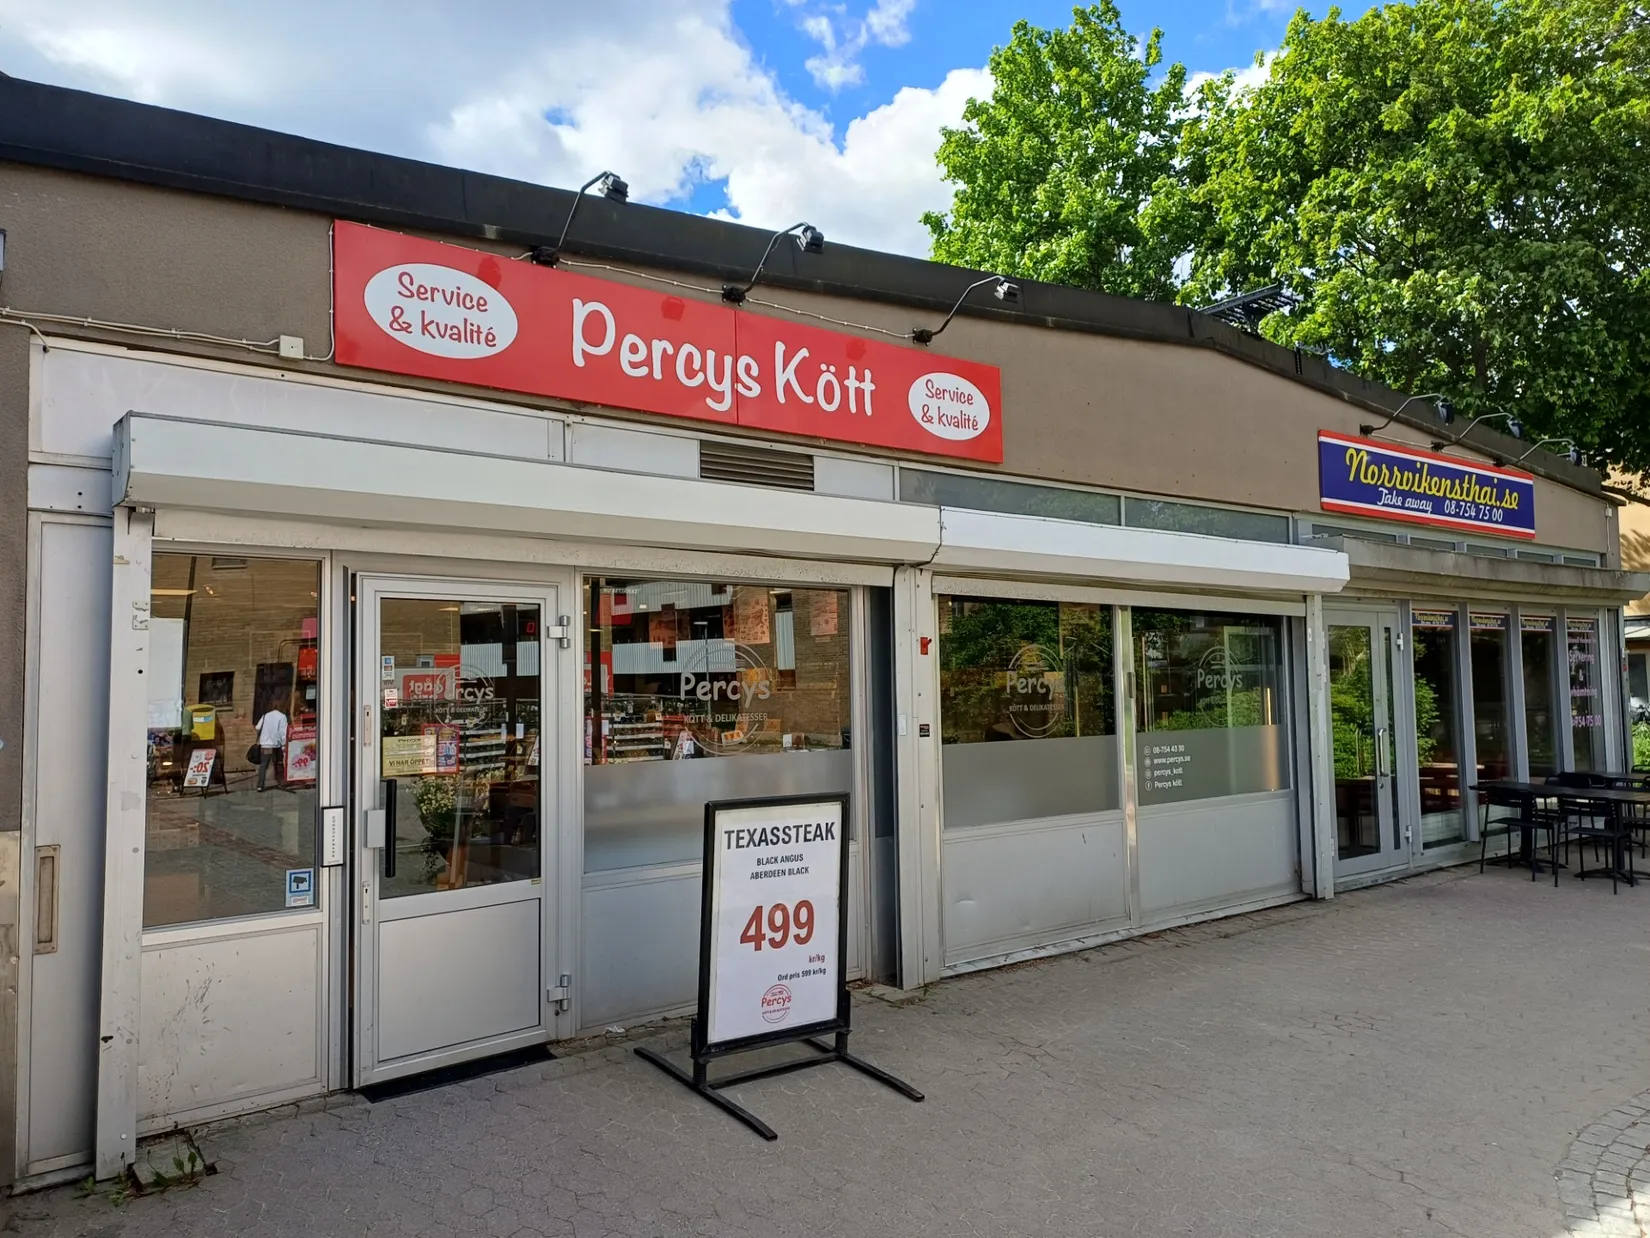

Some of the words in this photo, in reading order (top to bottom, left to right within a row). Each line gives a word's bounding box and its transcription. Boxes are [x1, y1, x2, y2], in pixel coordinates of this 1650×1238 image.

[397, 271, 488, 313] Service
[389, 306, 413, 334] &
[420, 310, 497, 348] kvalité
[572, 298, 761, 412] Percys
[774, 340, 876, 417] Kött
[925, 378, 974, 406] Service
[921, 404, 934, 424] &
[937, 406, 979, 432] kvalité
[1345, 448, 1519, 510] Norrvikensthai.se
[1377, 487, 1402, 506] Take
[1405, 499, 1433, 514] away
[1444, 499, 1476, 517] 08-754
[1479, 505, 1490, 519] 75
[1492, 508, 1503, 522] 00
[434, 681, 494, 704] Prcys
[680, 672, 770, 708] Percys
[1006, 670, 1063, 700] Percy
[1197, 668, 1243, 696] Percys
[1569, 685, 1597, 699] vhämtning
[684, 712, 705, 724] KÖTT
[707, 714, 714, 723] &
[715, 712, 768, 723] DELIKATESSER
[1153, 755, 1191, 765] www.percys.se
[1154, 781, 1172, 789] Percys
[724, 821, 836, 850] TEXASSTEAK
[750, 868, 786, 880] ABERDEEN
[787, 866, 810, 877] BLACK
[756, 855, 779, 867] BLACK
[780, 853, 804, 865] ANGUS
[739, 899, 815, 951] 499
[808, 953, 826, 964] kr/kg
[777, 973, 789, 982] Ord
[789, 971, 800, 981] pris
[801, 969, 812, 978] 599
[812, 967, 827, 975] kr/kg
[761, 995, 792, 1008] Percys
